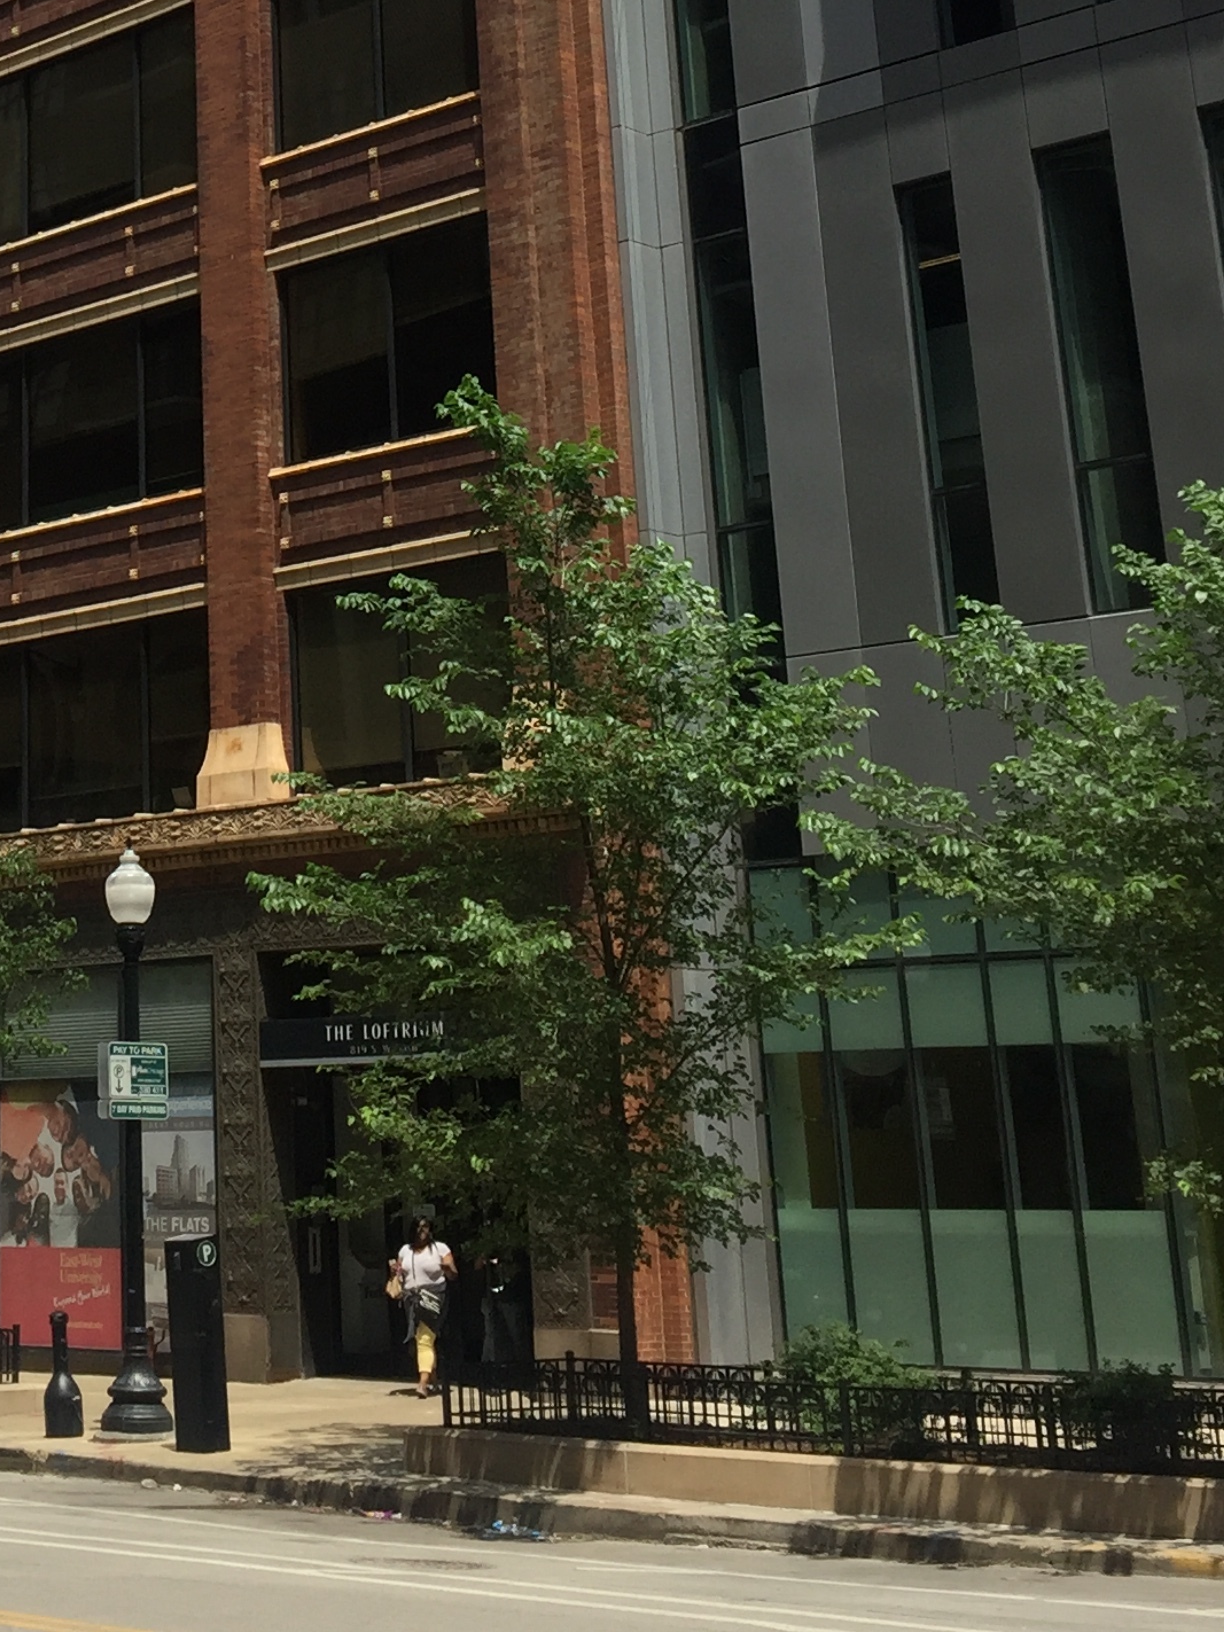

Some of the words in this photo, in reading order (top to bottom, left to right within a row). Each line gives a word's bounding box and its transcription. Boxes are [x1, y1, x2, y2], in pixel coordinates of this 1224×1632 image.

[325, 1023, 353, 1042] THE
[113, 1046, 127, 1054] PAY
[129, 1046, 140, 1055] TO
[141, 1047, 163, 1055] PARK
[117, 1105, 128, 1113] DAY
[142, 1105, 166, 1114] PARKING
[145, 1217, 168, 1233] THE
[171, 1216, 210, 1233] FLATS
[60, 1252, 103, 1268] East-West
[202, 1243, 212, 1263] P
[60, 1268, 103, 1286] University
